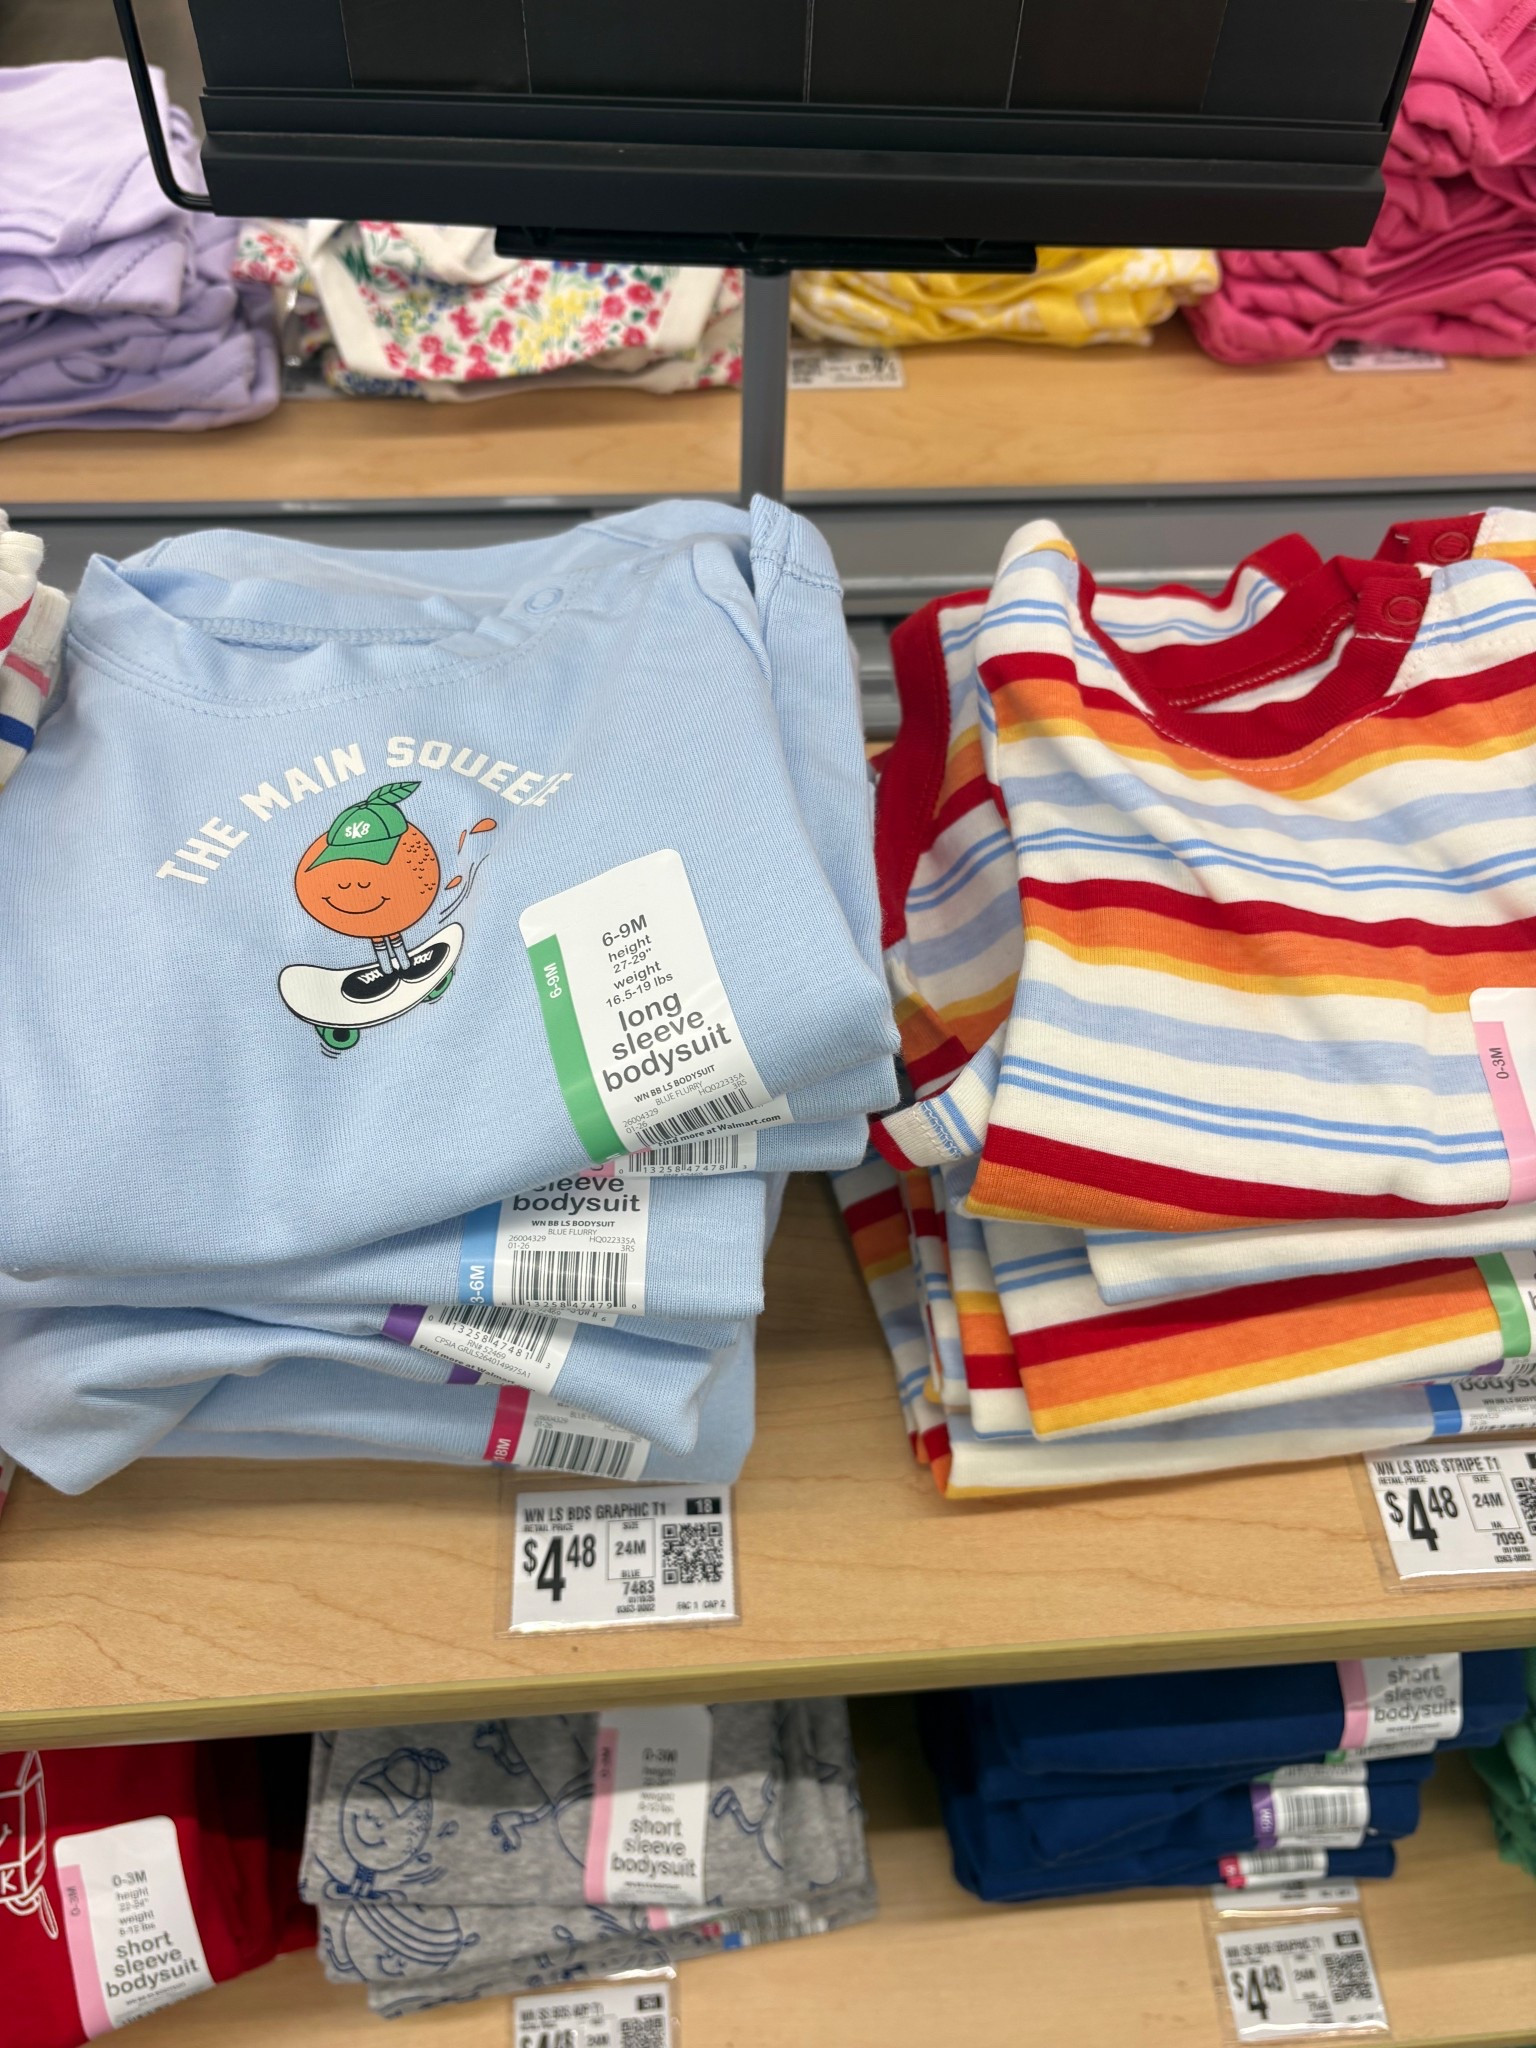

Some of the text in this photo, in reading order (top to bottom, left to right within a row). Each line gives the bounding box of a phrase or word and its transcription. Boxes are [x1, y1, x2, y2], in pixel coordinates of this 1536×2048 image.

[155, 816, 249, 885] THE
[239, 743, 367, 821] MAIN
[345, 821, 370, 839] SK8
[602, 914, 648, 947] 6-9M
[608, 935, 652, 962] height
[543, 962, 562, 998] 6-9M
[613, 961, 661, 989] weight
[606, 973, 673, 1007] 16.5-19 lbs
[618, 992, 682, 1031] long
[612, 1011, 704, 1061] sleeve
[602, 1023, 731, 1092] bodysuit
[1489, 1047, 1510, 1079] 0-3M
[634, 1064, 716, 1103] WN BB LS BODYSUIT
[655, 1081, 704, 1106] BLUE FLURRY
[622, 1108, 659, 1128] 26004329
[625, 1121, 648, 1134] 01-26
[683, 1130, 705, 1141] more
[706, 1126, 716, 1135] at
[717, 1114, 781, 1131] Walmart.com
[512, 1193, 640, 1216] bodysuit
[470, 1265, 485, 1304] 3-6M
[434, 1335, 457, 1350] CPSIA
[467, 1340, 507, 1360] RN# 52469
[440, 1353, 464, 1365] more
[1374, 1461, 1395, 1476] WN
[1398, 1460, 1412, 1474] LS
[1442, 1456, 1484, 1472] STRIPE
[524, 1508, 545, 1523] WN
[550, 1507, 564, 1522] LS
[567, 1505, 592, 1521] BDS
[596, 1502, 649, 1519] GRAPHIC
[652, 1501, 666, 1516] T1
[1472, 1493, 1504, 1508] 24M
[615, 1540, 646, 1556] 24M
[1493, 1532, 1526, 1546] 7099
[623, 1580, 655, 1595] 7483
[1384, 1684, 1447, 1704] sleeve
[1374, 1698, 1457, 1723] bodysuit
[630, 1815, 682, 1836] short
[623, 1834, 687, 1856] sleeve
[611, 1852, 697, 1879] bodysuit
[112, 1870, 148, 1887] 0-3M
[116, 1931, 173, 1958] short
[114, 1948, 182, 1978] sleeve
[106, 1958, 199, 1998] bodysuit
